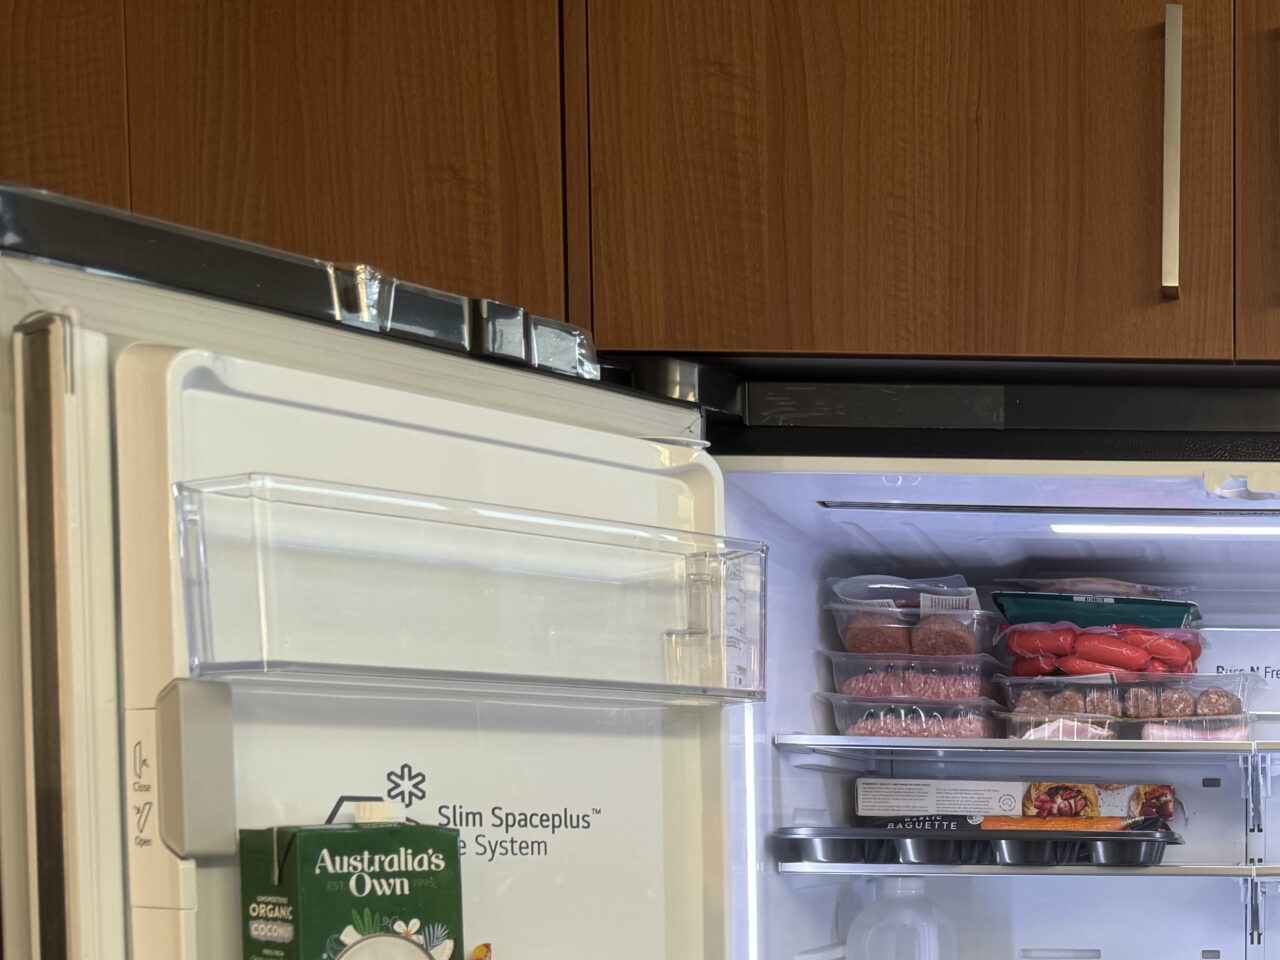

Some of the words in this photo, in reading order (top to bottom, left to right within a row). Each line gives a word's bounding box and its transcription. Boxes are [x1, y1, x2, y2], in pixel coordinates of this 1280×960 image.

[133, 781, 152, 793] Close
[437, 805, 483, 828] Slim
[887, 820, 957, 830] BAGUETTE
[134, 836, 153, 848] Open
[474, 834, 548, 857] System
[315, 847, 446, 875] Australia's
[349, 871, 411, 897] Own
[249, 903, 294, 920] ORGANIC
